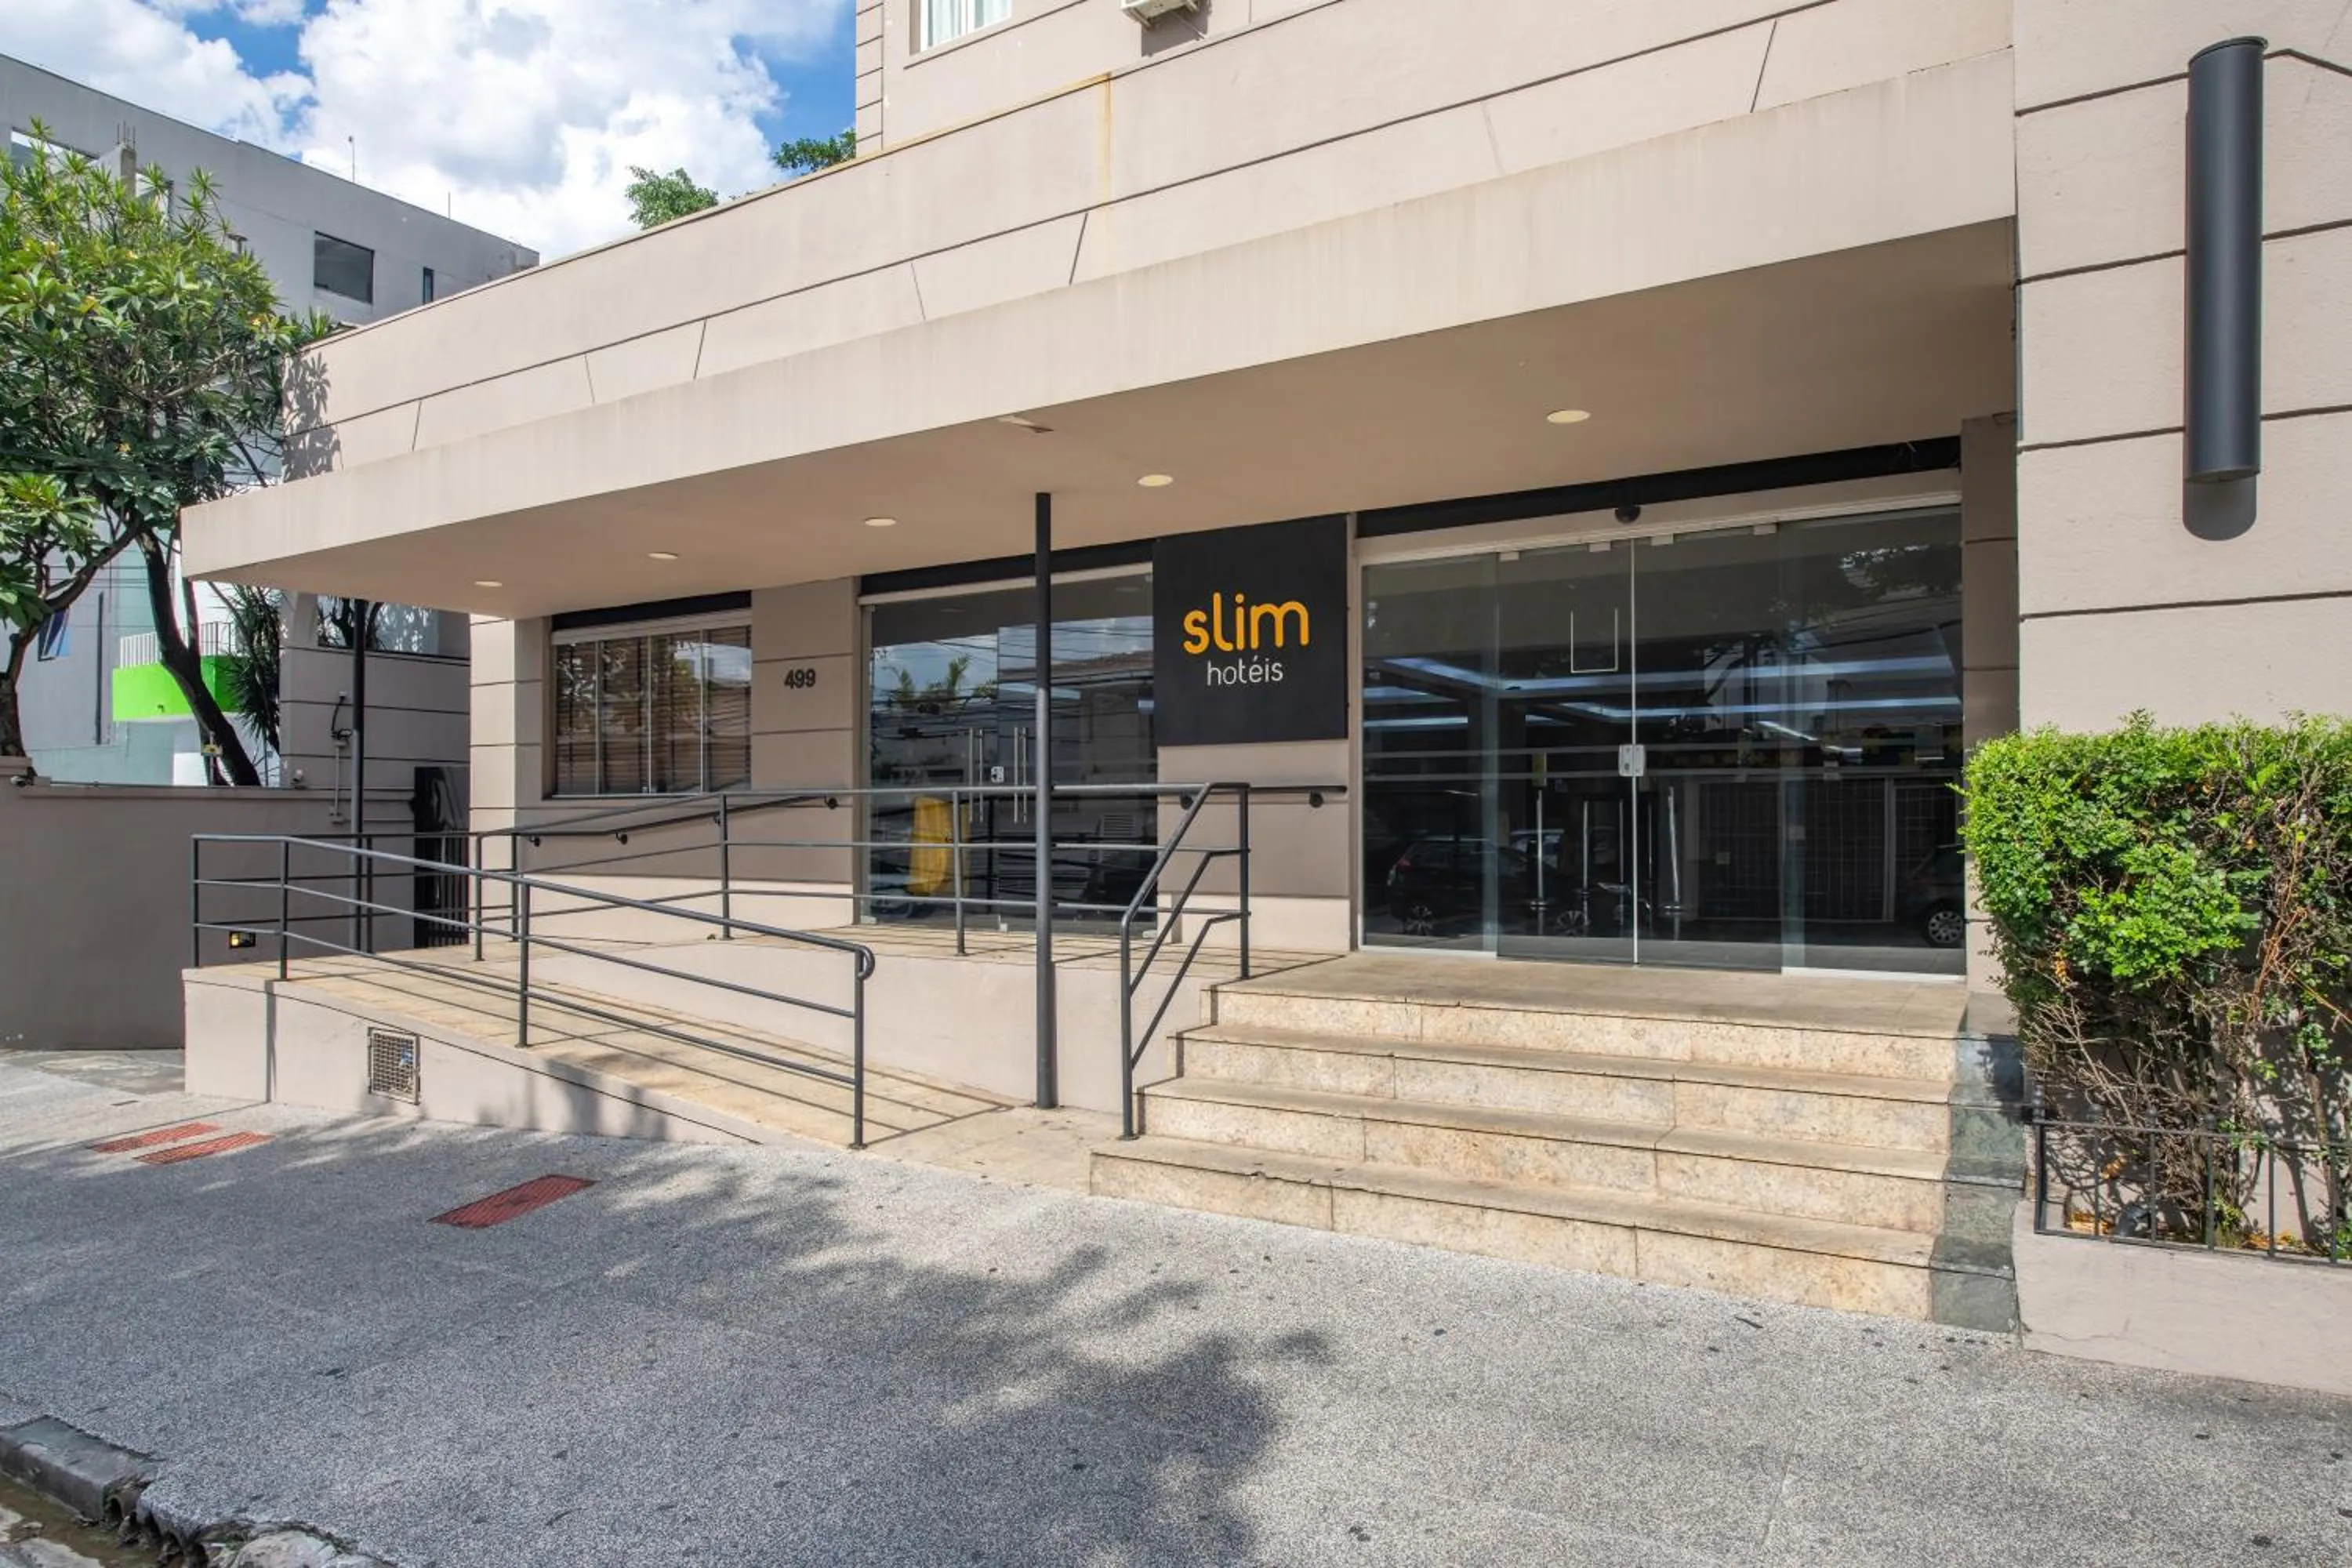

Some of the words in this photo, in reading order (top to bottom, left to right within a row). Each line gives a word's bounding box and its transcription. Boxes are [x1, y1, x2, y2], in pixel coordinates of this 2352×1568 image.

[1183, 592, 1309, 655] slim
[784, 669, 816, 689] 499
[1207, 655, 1283, 686] hotéis
